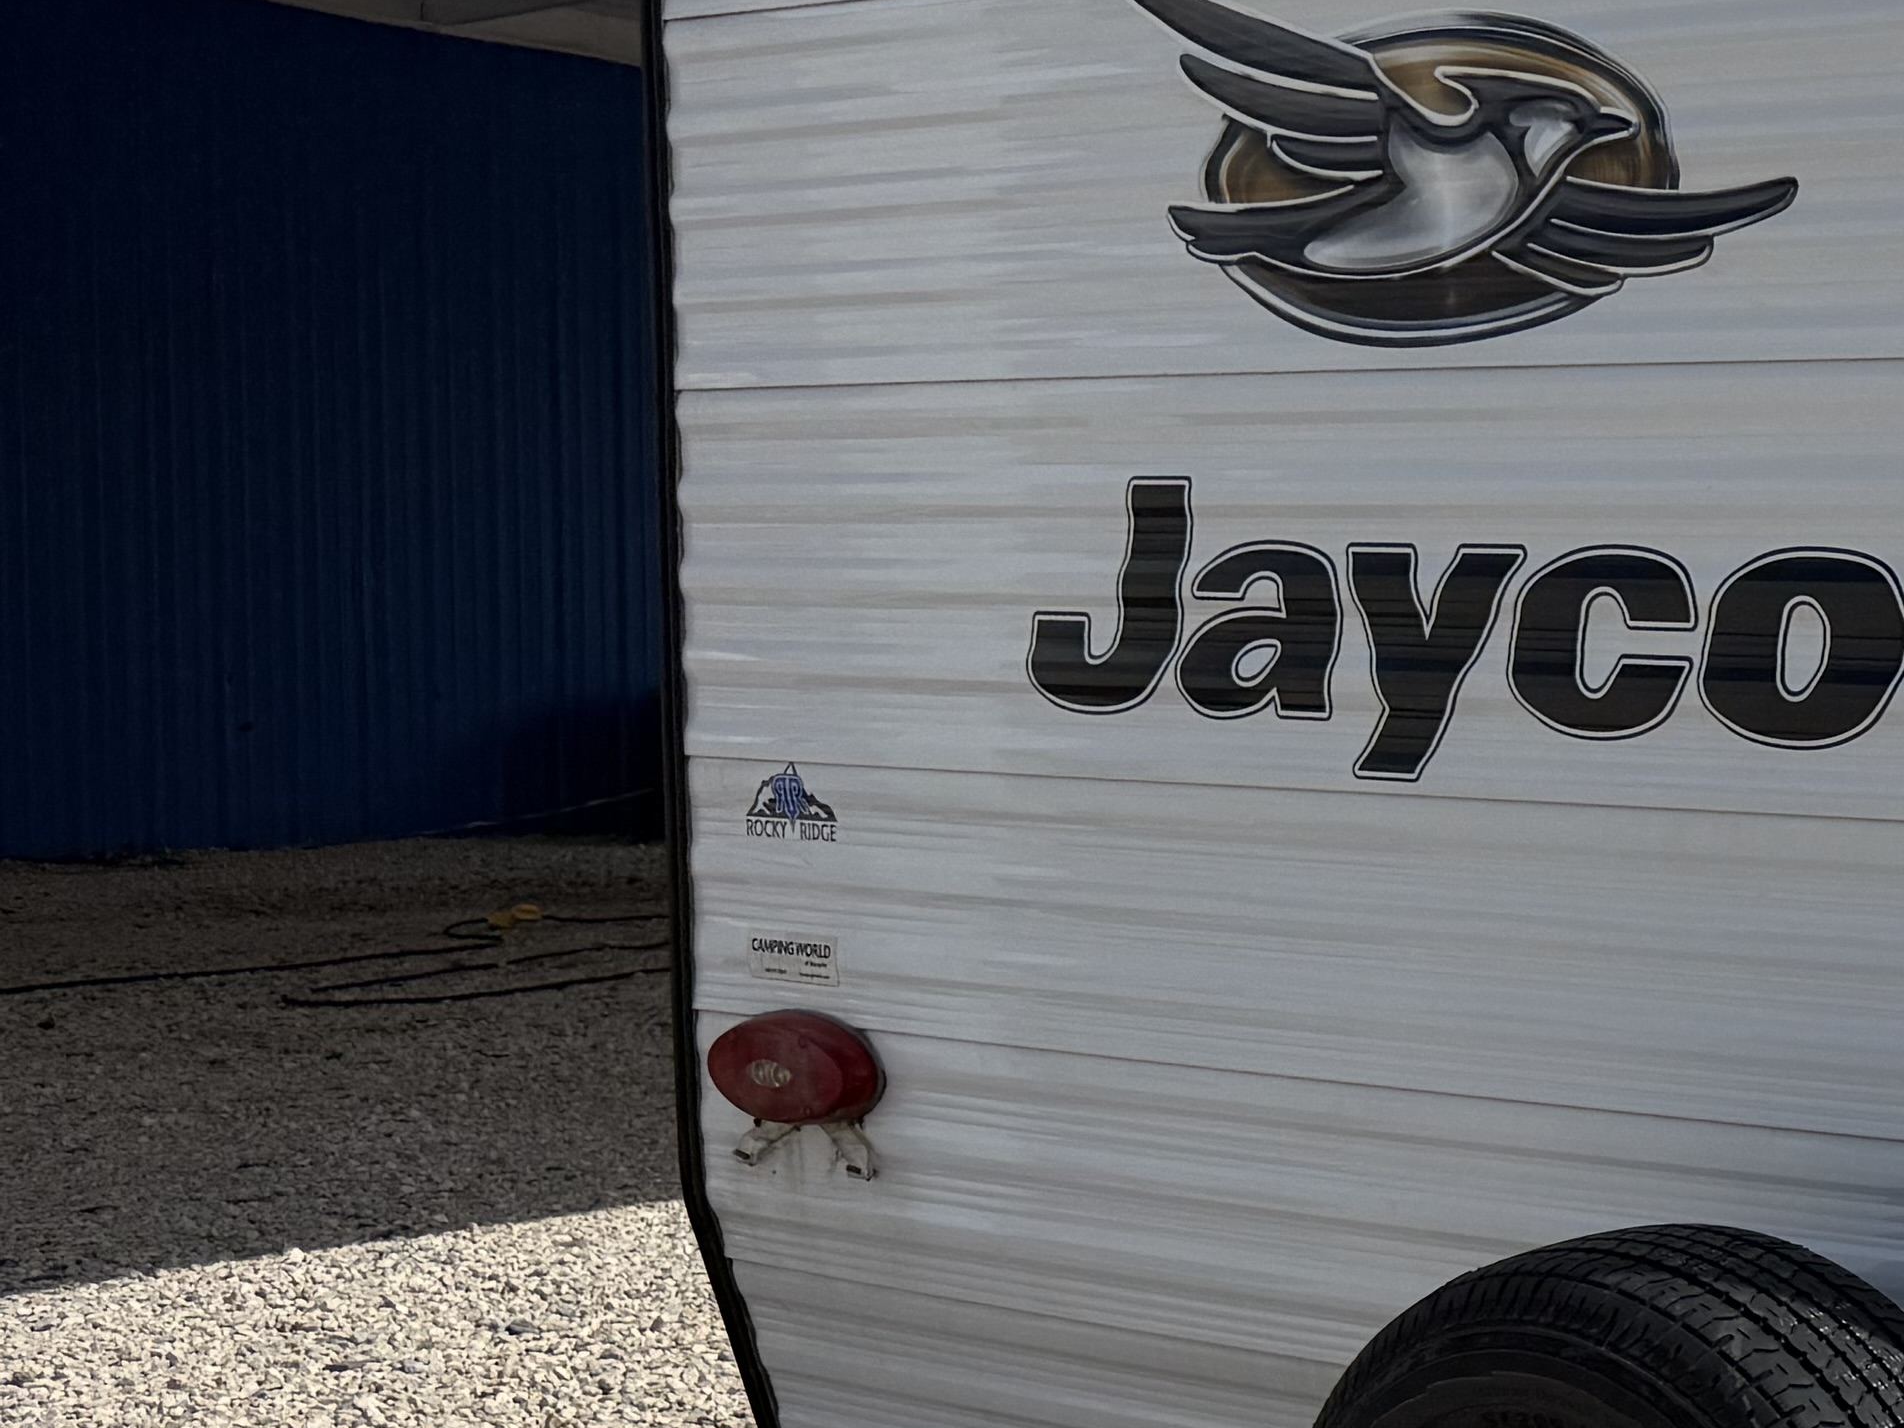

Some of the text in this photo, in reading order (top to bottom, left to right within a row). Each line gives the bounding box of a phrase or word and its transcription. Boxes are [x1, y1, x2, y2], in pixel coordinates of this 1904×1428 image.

[746, 818, 837, 842] ROCKY RIDGE
[752, 938, 831, 959] CAMPING WORLD
